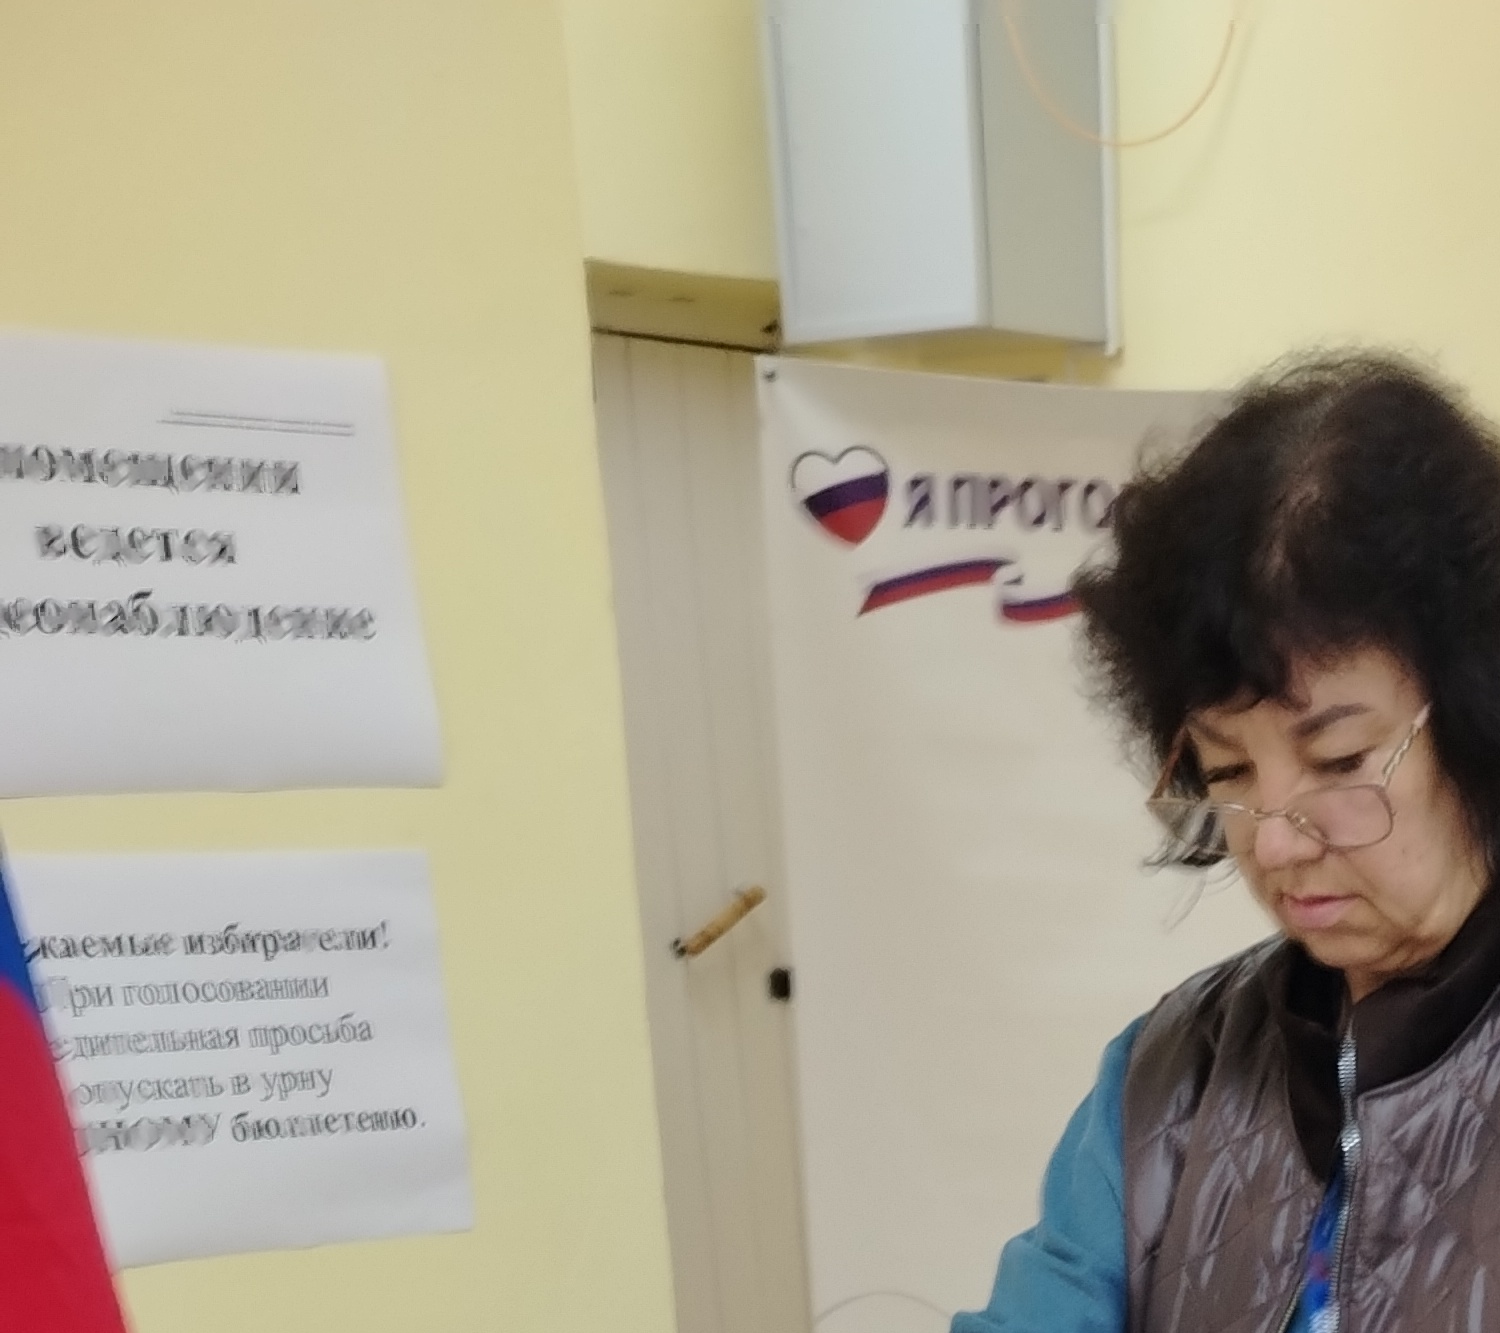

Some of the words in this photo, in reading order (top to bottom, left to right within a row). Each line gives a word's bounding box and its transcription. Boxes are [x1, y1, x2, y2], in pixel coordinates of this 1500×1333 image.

[904, 473, 938, 529] Я
[948, 473, 1118, 533] ПРОГО
[34, 522, 238, 567] ведется
[0, 588, 378, 643] еонаблюдение
[122, 973, 331, 1006] голосовании
[50, 1026, 240, 1062] едительная
[248, 1012, 375, 1055] просьба
[231, 1077, 252, 1099] в
[261, 1066, 334, 1104] урну
